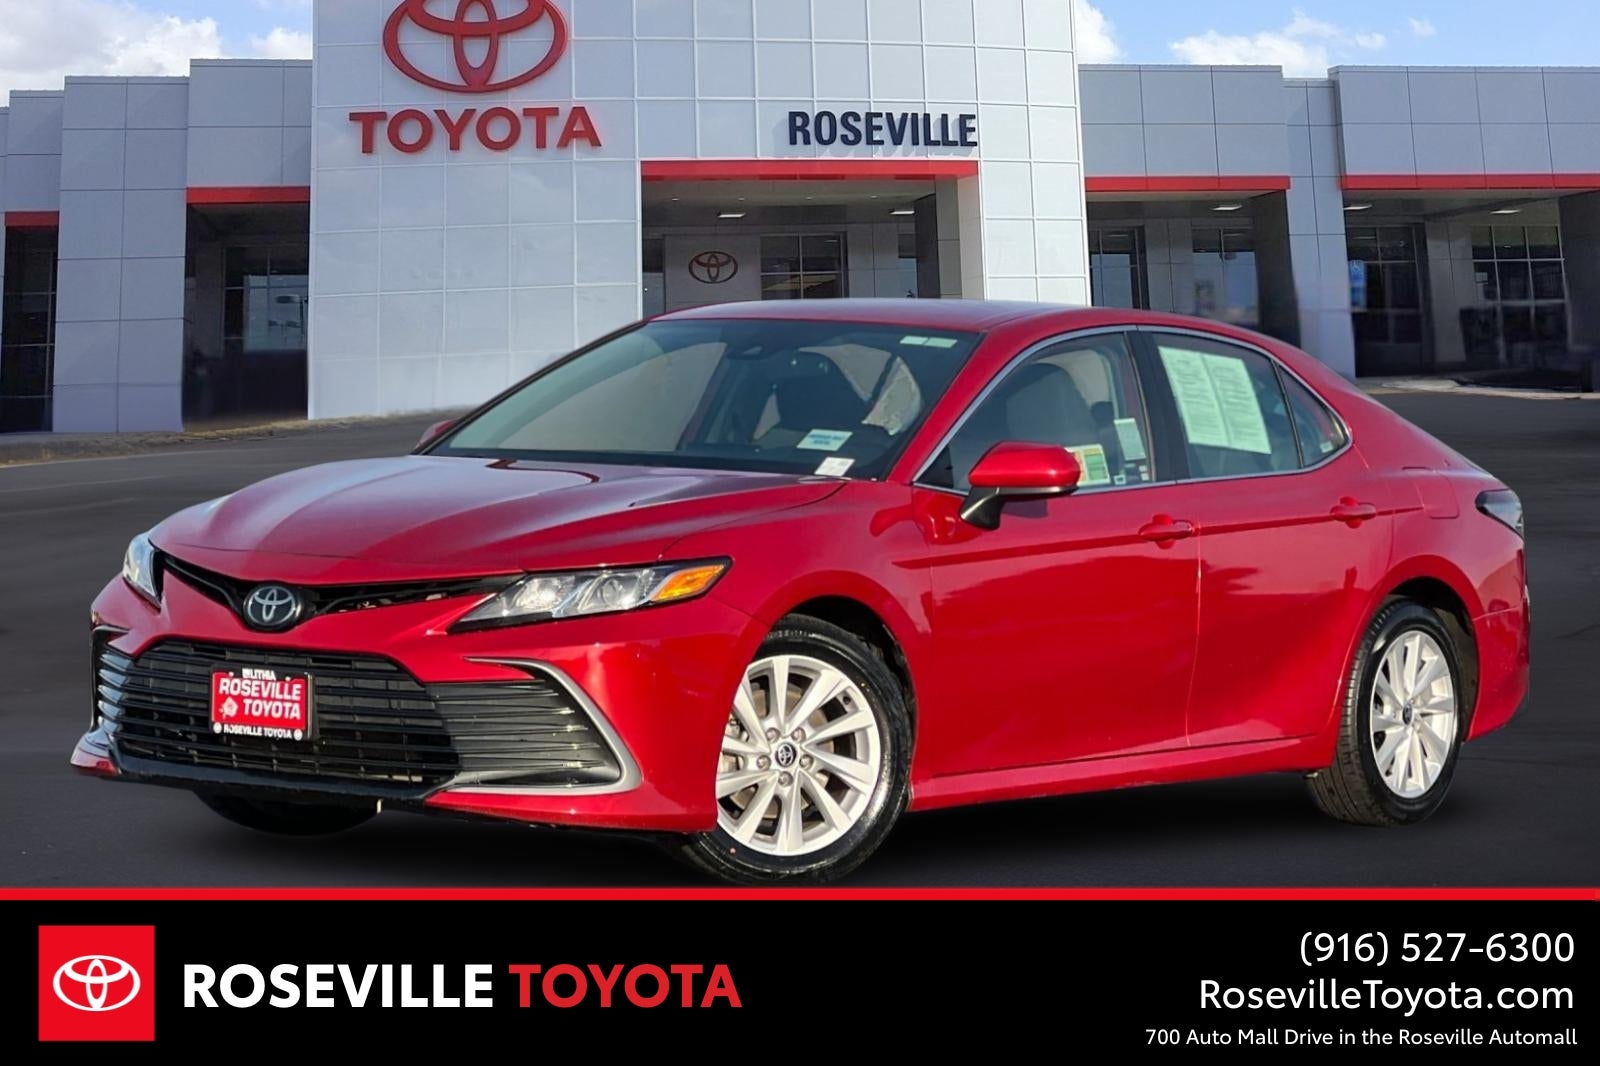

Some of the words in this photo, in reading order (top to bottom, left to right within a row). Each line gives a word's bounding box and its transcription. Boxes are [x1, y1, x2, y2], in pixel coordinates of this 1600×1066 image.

[349, 106, 602, 154] TOYOTA
[788, 110, 978, 147] ROSEVILLE
[219, 678, 302, 701] ROSEVILLE
[243, 699, 301, 720] TOYOTA
[223, 724, 263, 737] ROSEVILLE
[263, 727, 293, 740] TOYOTA
